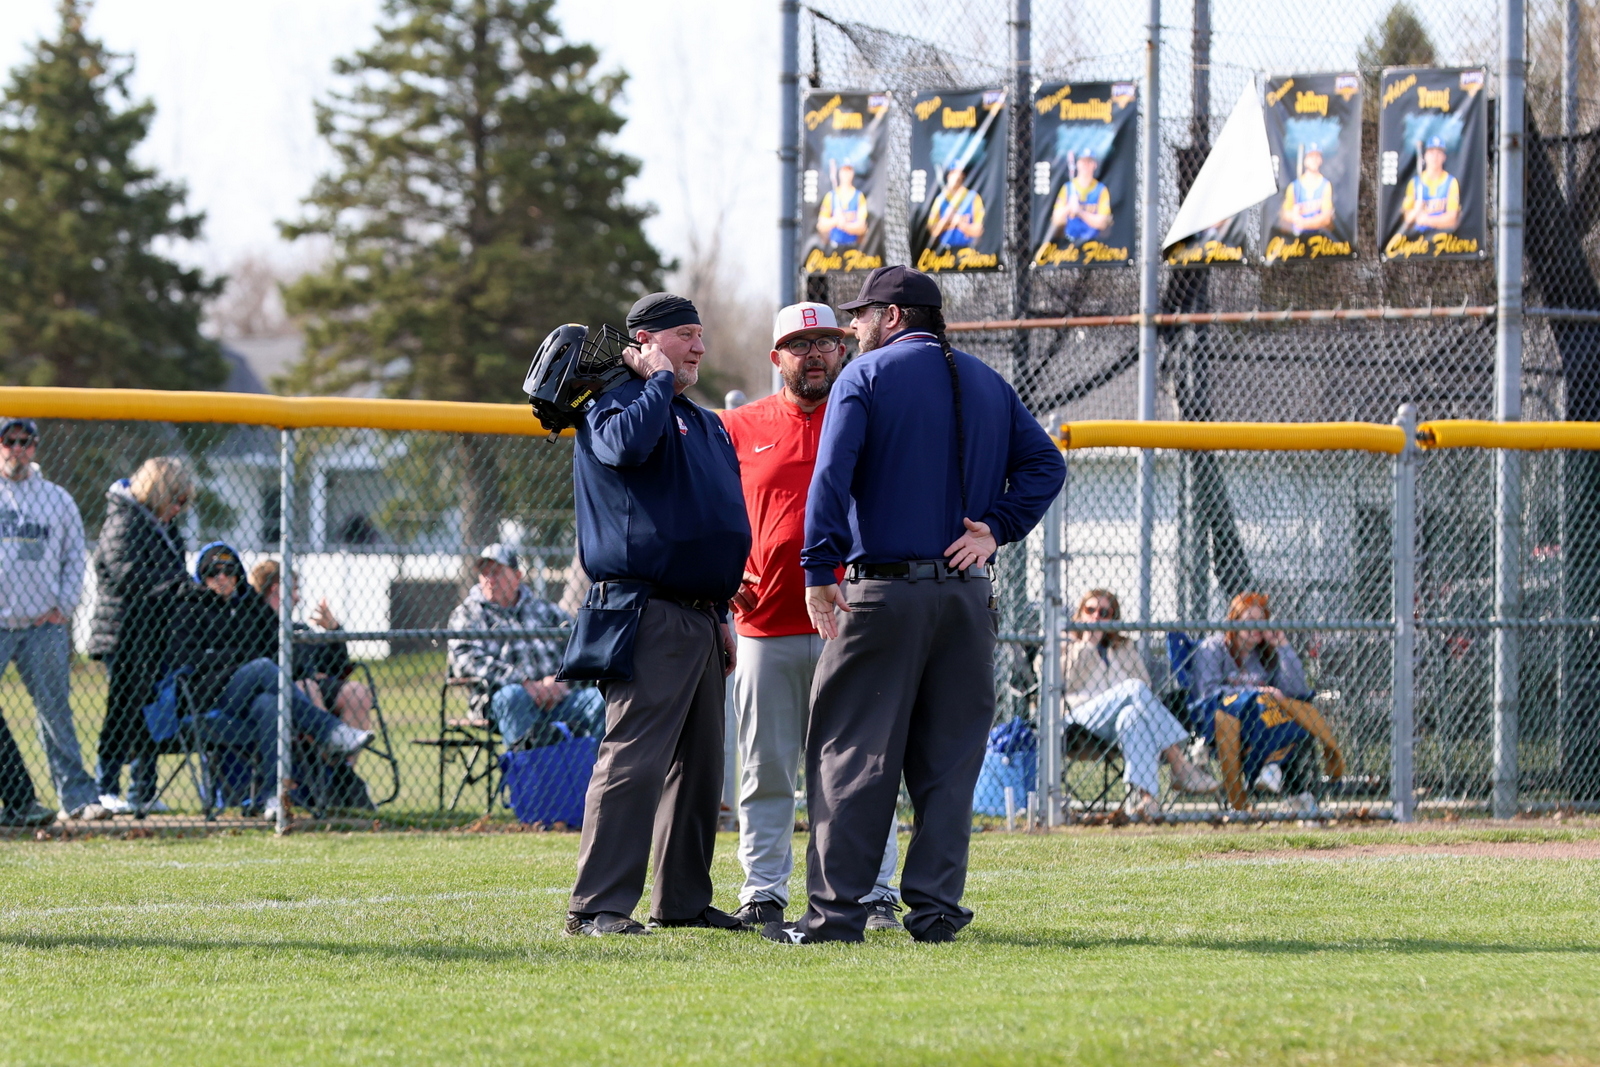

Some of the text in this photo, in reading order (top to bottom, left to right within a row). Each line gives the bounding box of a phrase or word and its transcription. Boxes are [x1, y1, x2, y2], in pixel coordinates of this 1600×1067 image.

[1034, 240, 1128, 267] Clyde Fliers
[1204, 240, 1243, 265] Fliers
[1265, 235, 1351, 262] Clyde Fliers
[1385, 232, 1478, 259] Clyde Fliers
[805, 248, 882, 274] Clyde Fliers
[917, 247, 998, 273] Clyde Fliers
[801, 308, 818, 328] B
[570, 389, 592, 408] Wilson
